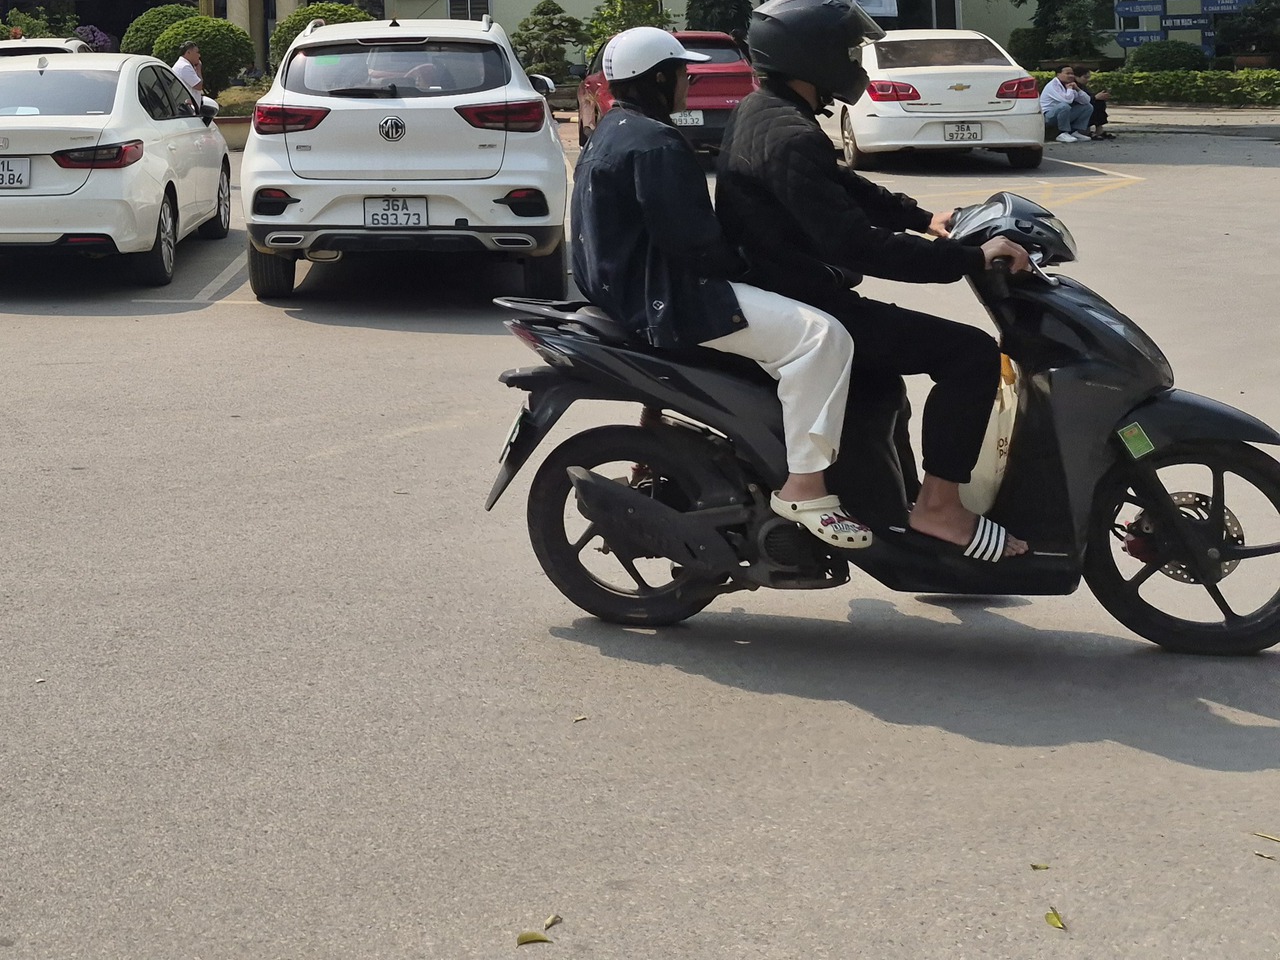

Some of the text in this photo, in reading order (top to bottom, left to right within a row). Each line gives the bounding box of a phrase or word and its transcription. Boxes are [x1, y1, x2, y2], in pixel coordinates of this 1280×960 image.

[381, 118, 405, 140] MG
[955, 124, 971, 132] 36A
[382, 199, 410, 212] 36A
[371, 213, 421, 226] 693.73
